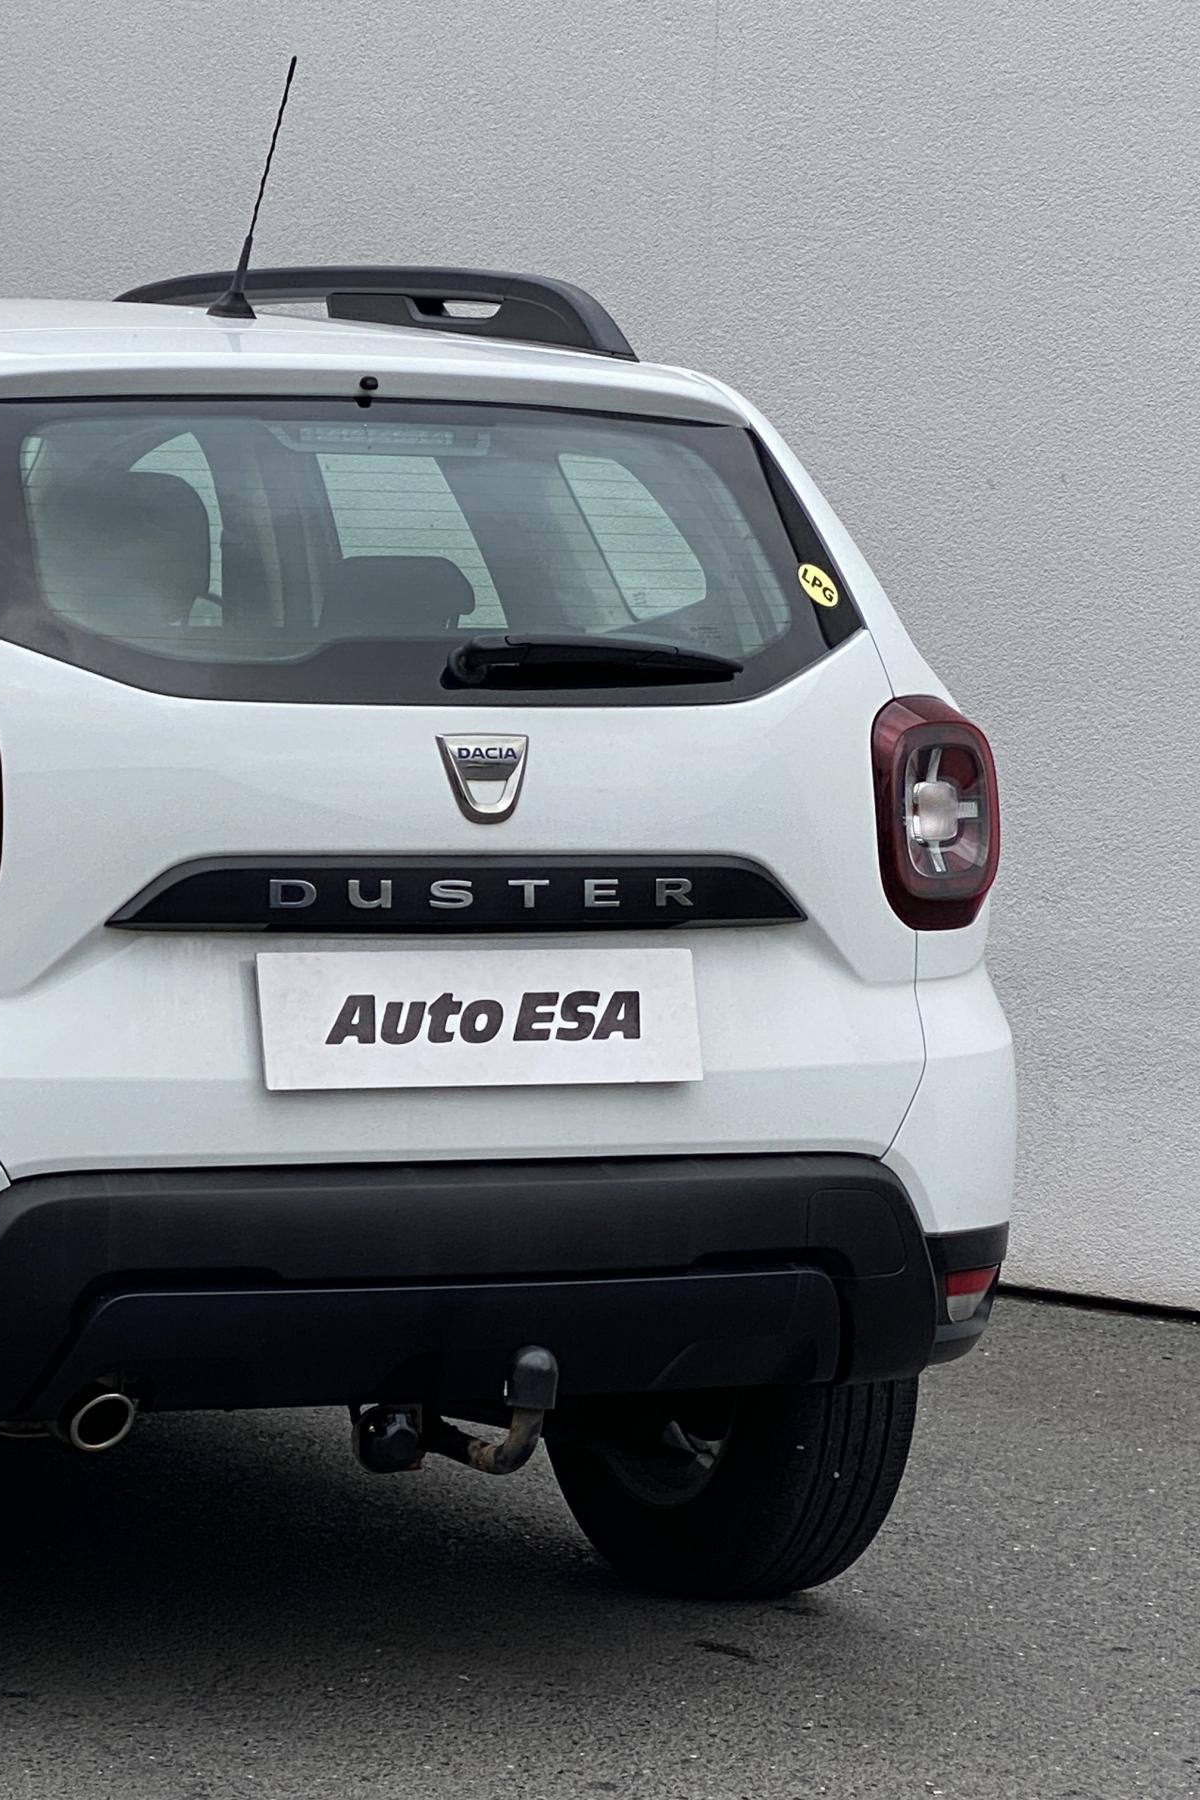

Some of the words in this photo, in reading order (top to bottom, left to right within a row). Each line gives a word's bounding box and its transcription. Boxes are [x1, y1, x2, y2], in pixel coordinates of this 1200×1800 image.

[801, 567, 835, 603] LPG
[456, 747, 518, 760] DACIA
[268, 877, 695, 910] DUSTER
[324, 991, 505, 1045] Auto
[512, 990, 642, 1042] ESA
